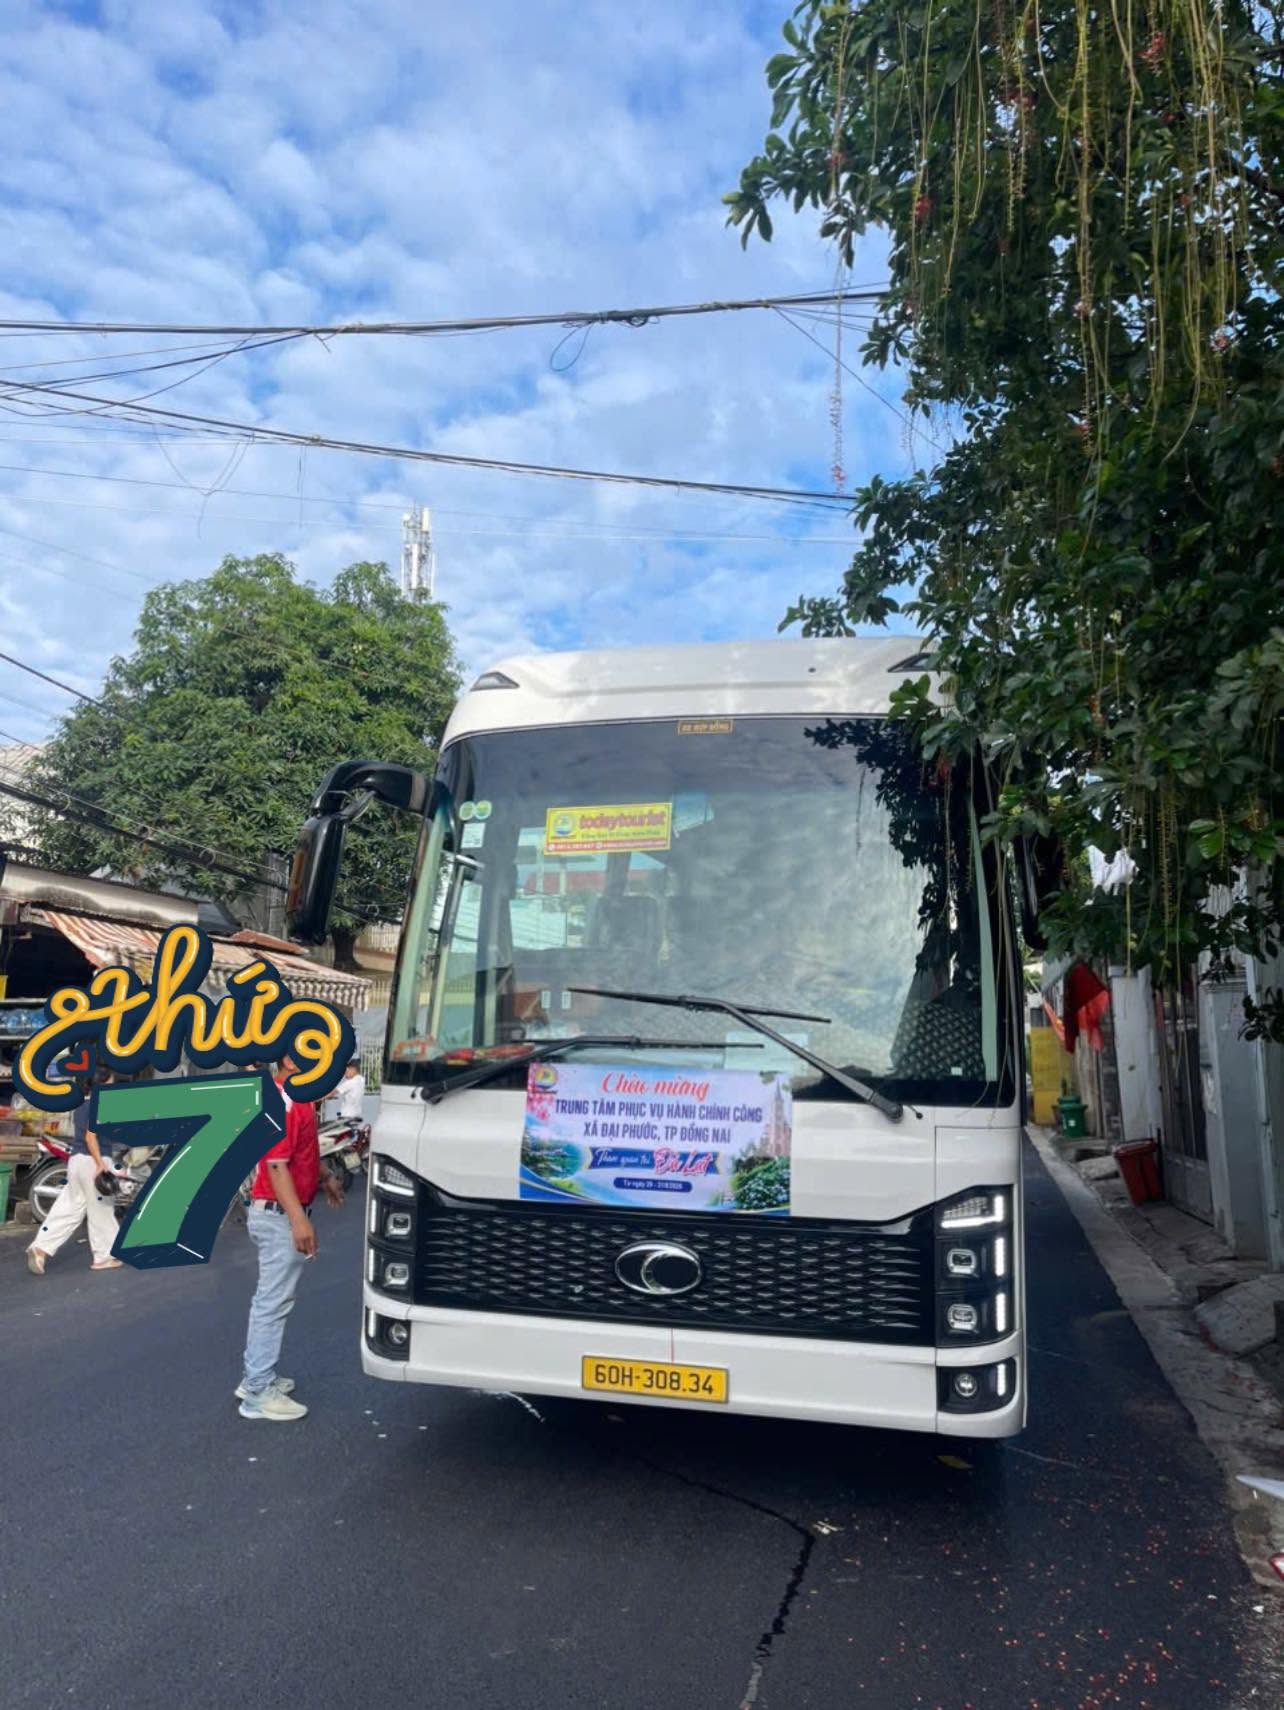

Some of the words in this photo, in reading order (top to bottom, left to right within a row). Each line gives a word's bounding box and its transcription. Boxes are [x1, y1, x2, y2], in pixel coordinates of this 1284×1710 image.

[653, 1075, 710, 1102] mừng
[555, 1098, 589, 1115] TRUNG
[592, 1097, 616, 1116] TÂM
[618, 1101, 647, 1120] PHỤC
[649, 1102, 664, 1119] VỤ
[666, 1101, 697, 1119] HÀNH
[698, 1102, 731, 1121] CHÍNH
[732, 1104, 763, 1123] CÔNG
[583, 1119, 598, 1137] XÃ
[601, 1122, 619, 1141] ĐẠI
[621, 1120, 661, 1141] PHƯỚC,
[664, 1125, 678, 1140] TP
[680, 1121, 709, 1143] ĐỒNG
[711, 1127, 731, 1143] NAI
[594, 1363, 715, 1396] 60H-308.34
